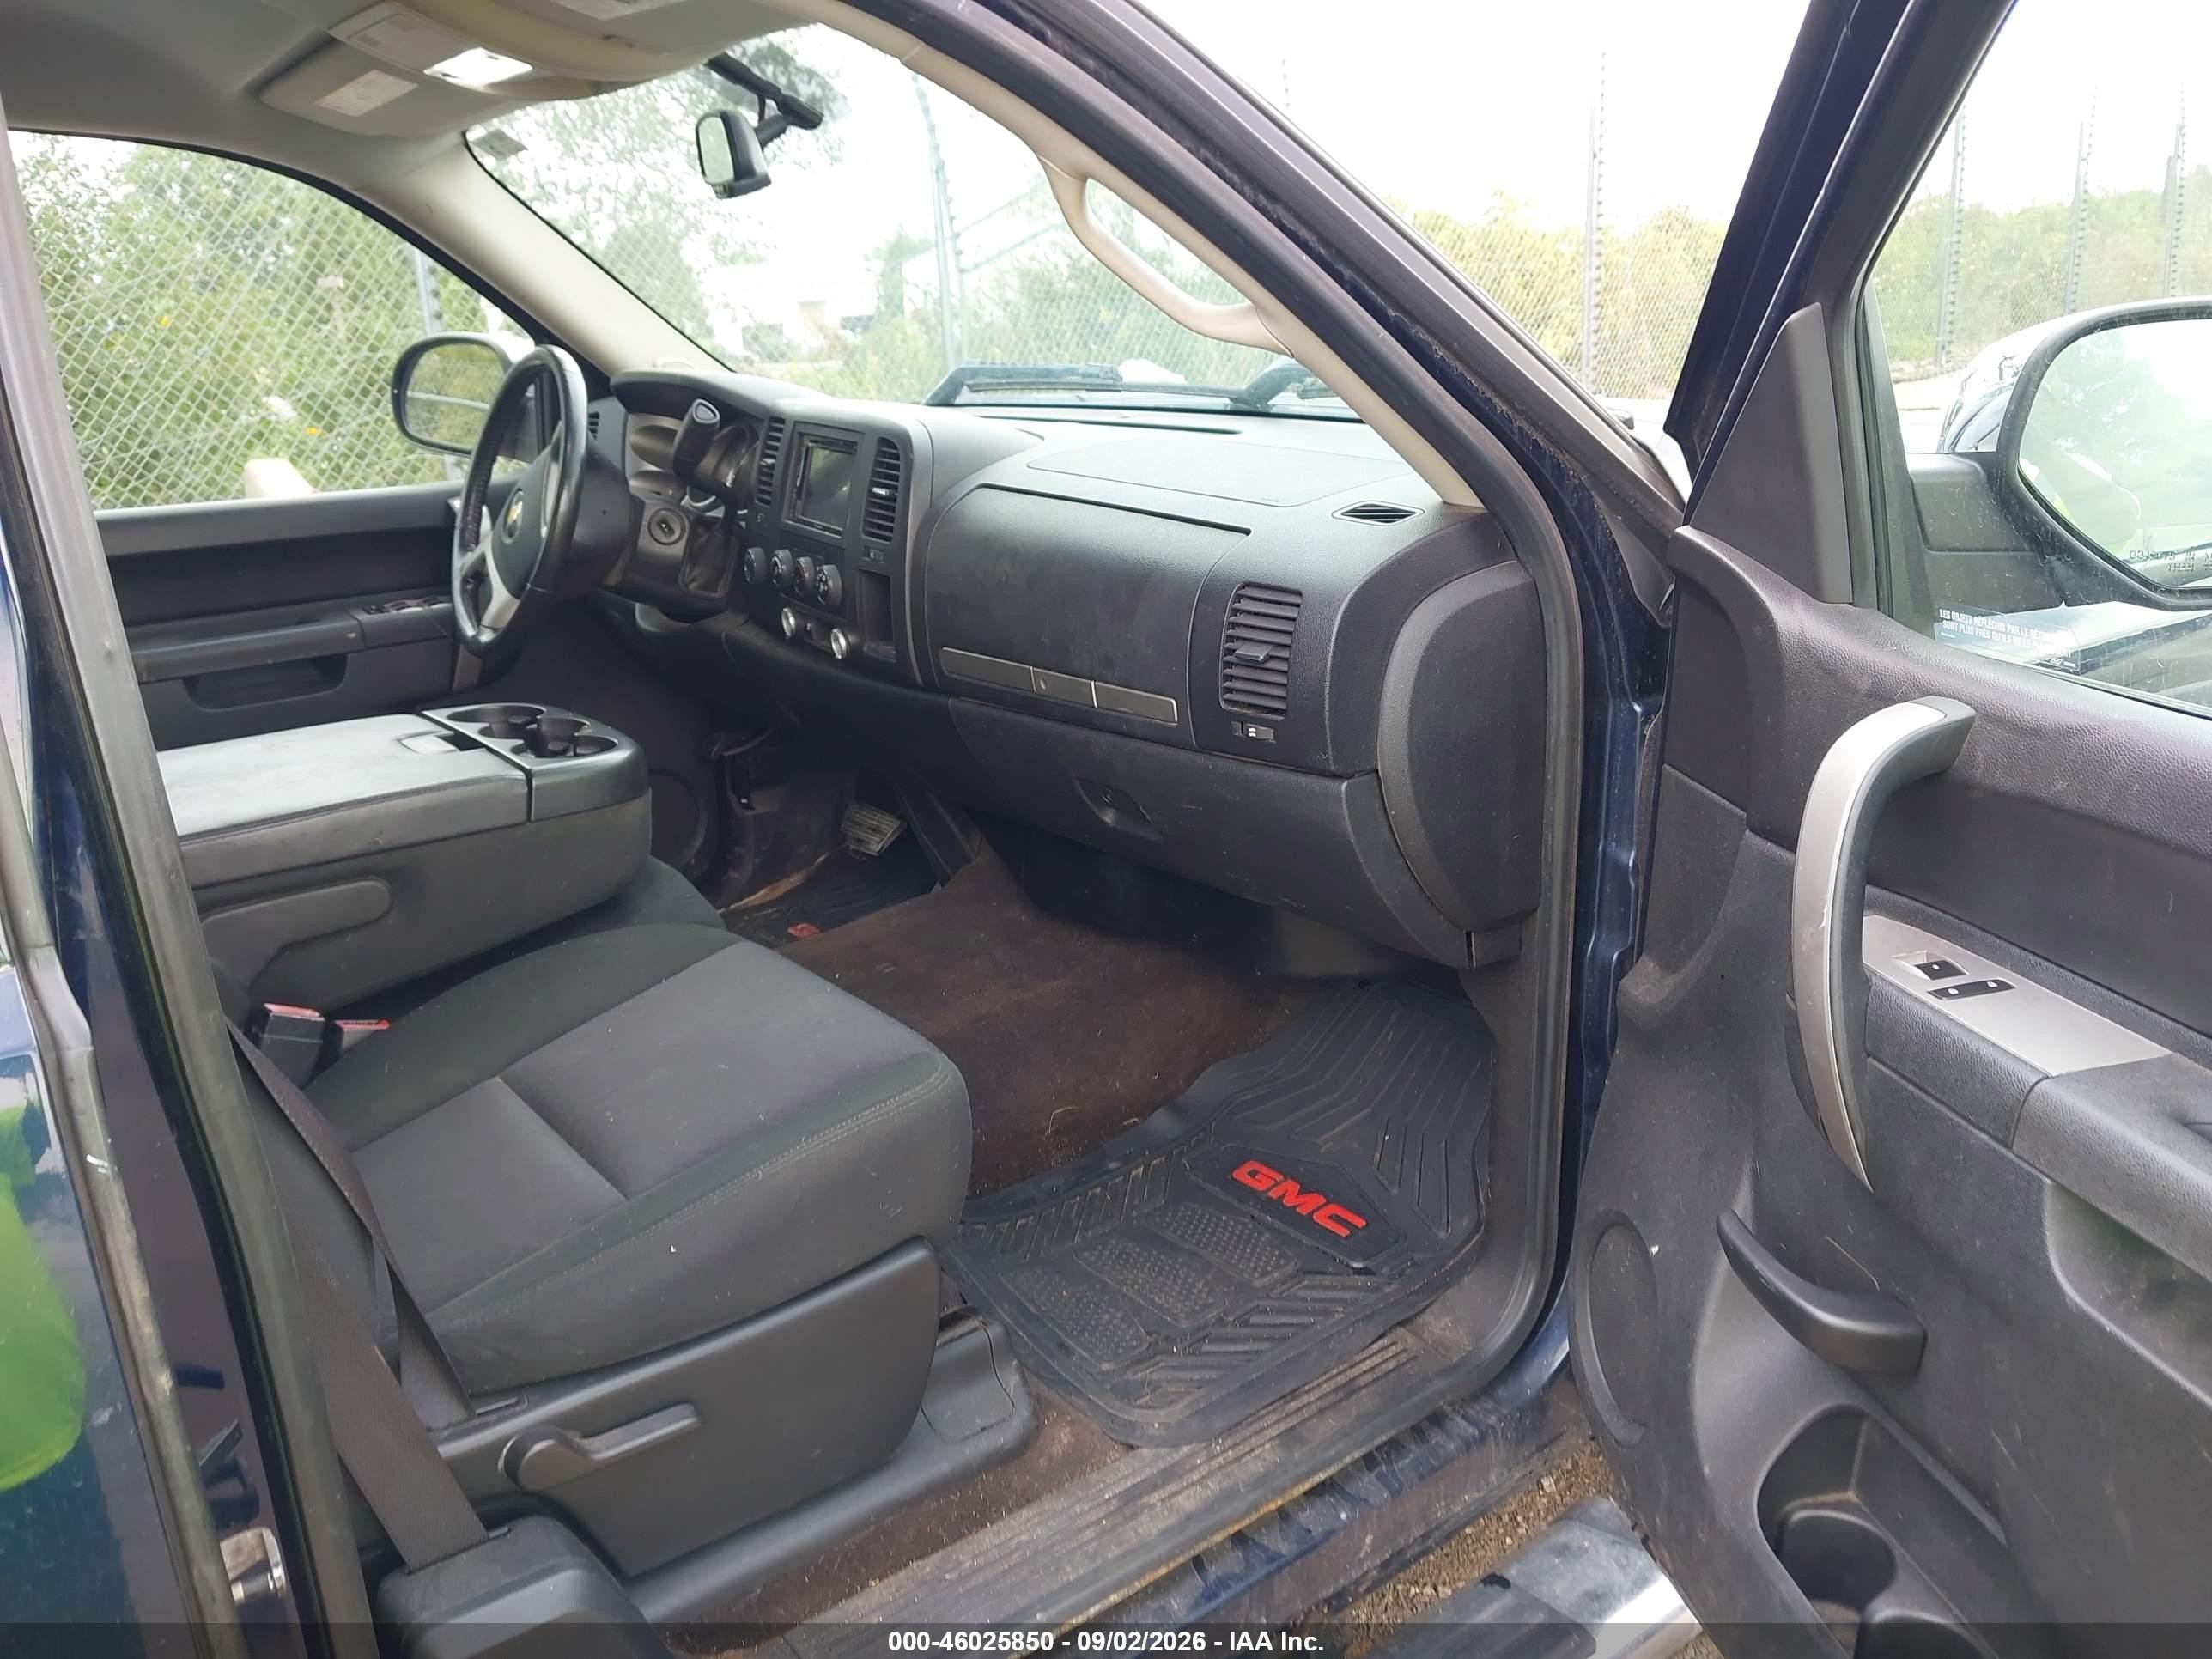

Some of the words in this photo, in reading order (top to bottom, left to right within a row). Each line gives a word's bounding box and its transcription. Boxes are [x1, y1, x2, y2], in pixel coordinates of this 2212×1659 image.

[1939, 609, 1951, 620] LES
[1951, 611, 1973, 626] OBJETS
[2007, 623, 2020, 635] PAR
[1942, 620, 1958, 632] SONT
[1959, 623, 1974, 635] PLUS
[1975, 627, 1991, 640] PRÈS
[1231, 1160, 1367, 1237] GMC
